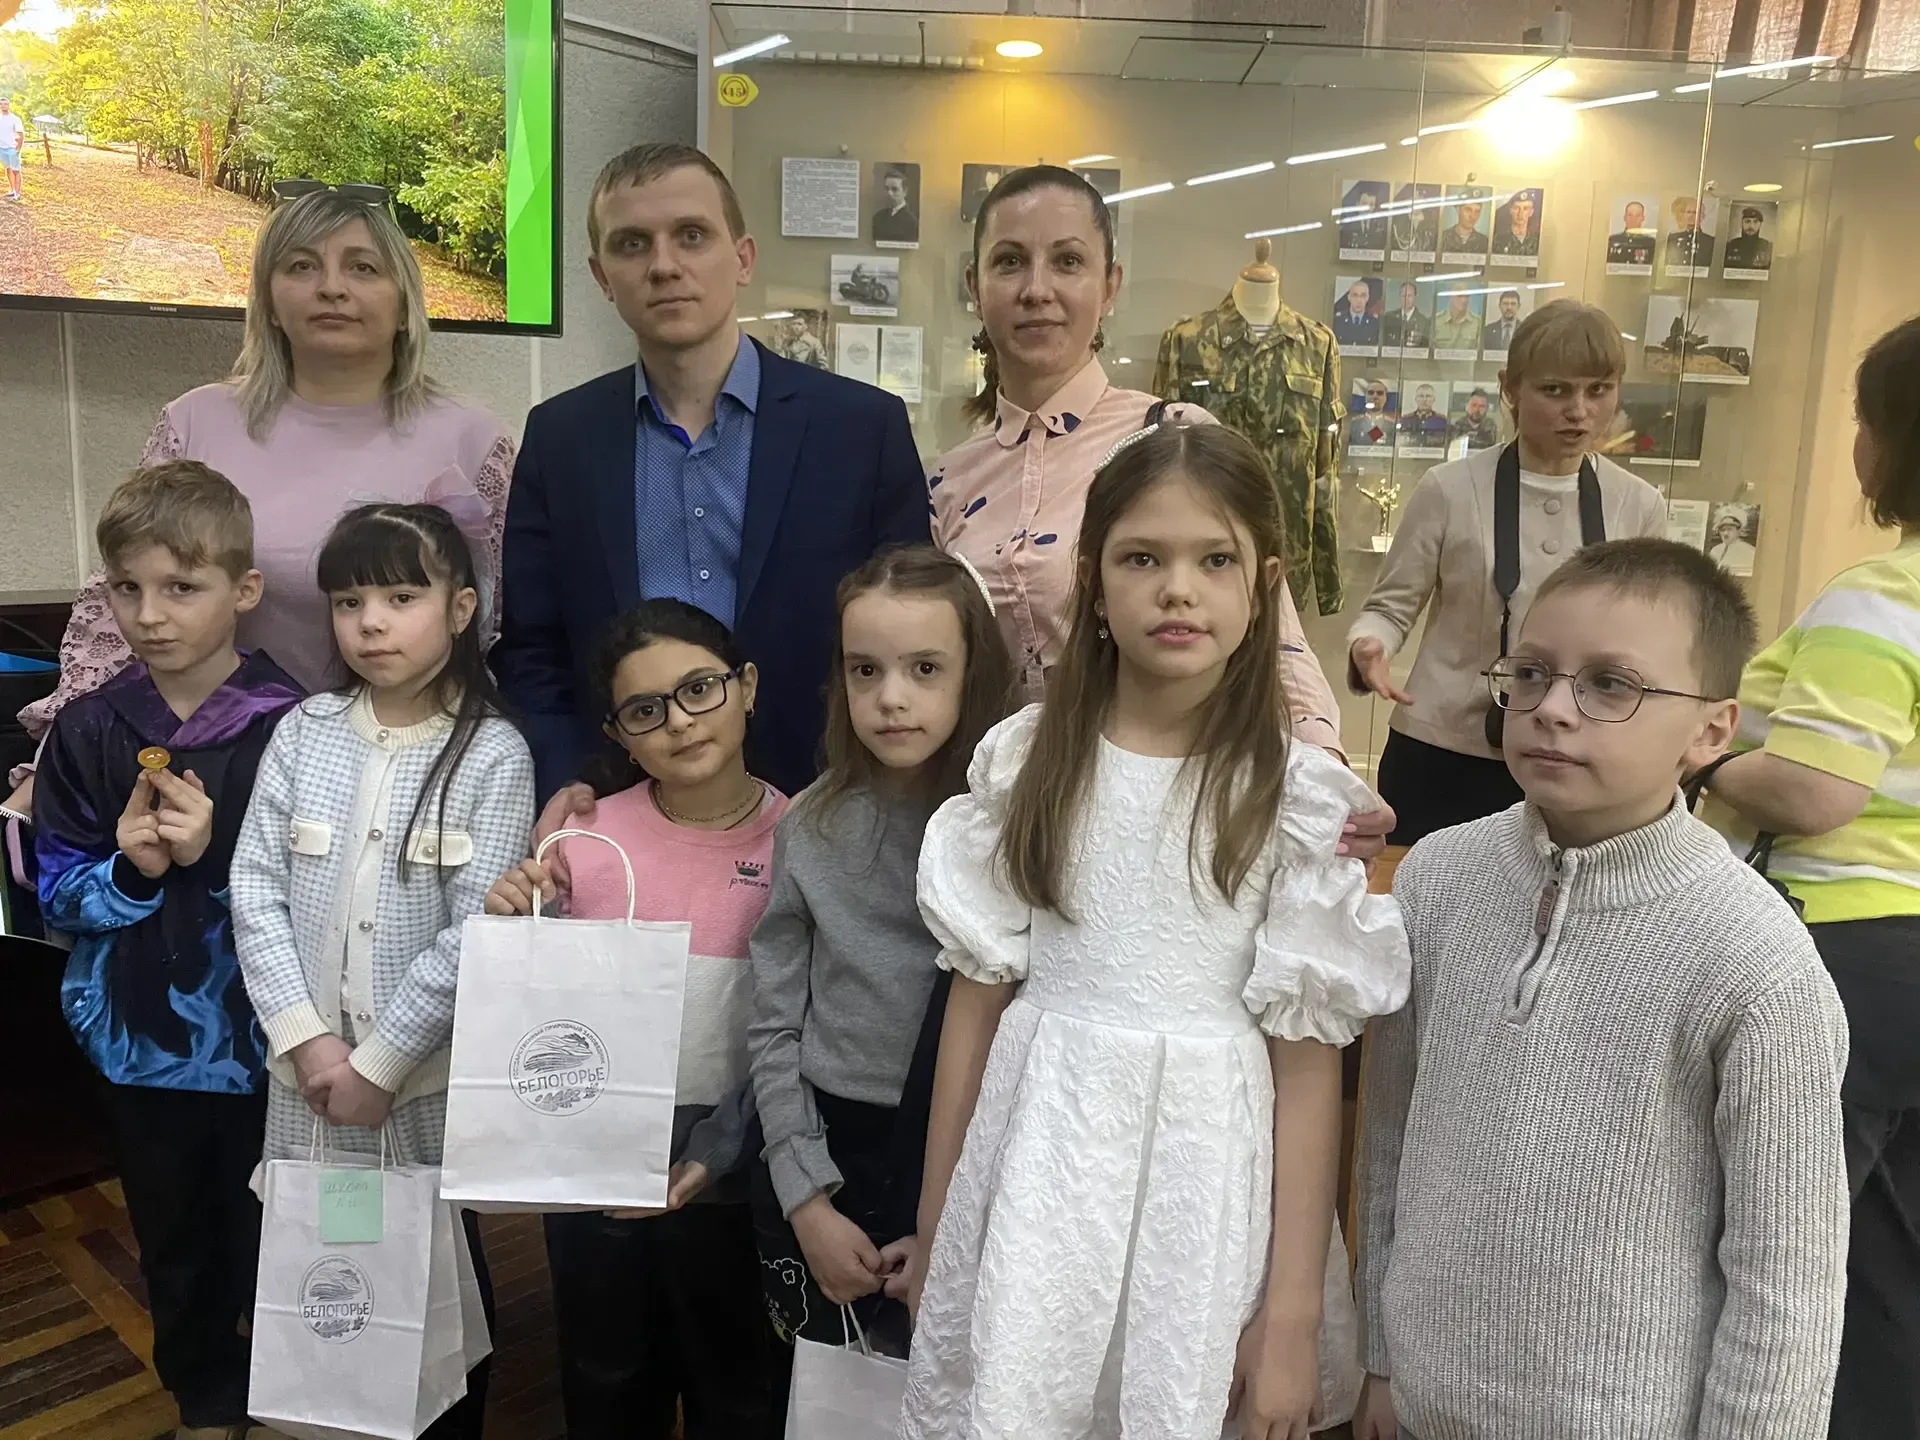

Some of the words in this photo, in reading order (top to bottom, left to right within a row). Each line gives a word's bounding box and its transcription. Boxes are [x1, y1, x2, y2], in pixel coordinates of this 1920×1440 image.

[149, 305, 177, 313] SAMSUNG
[518, 1067, 605, 1095] БЕЛОГОРЬЕ
[303, 1302, 370, 1318] БЕЛОГОРЬЕ
